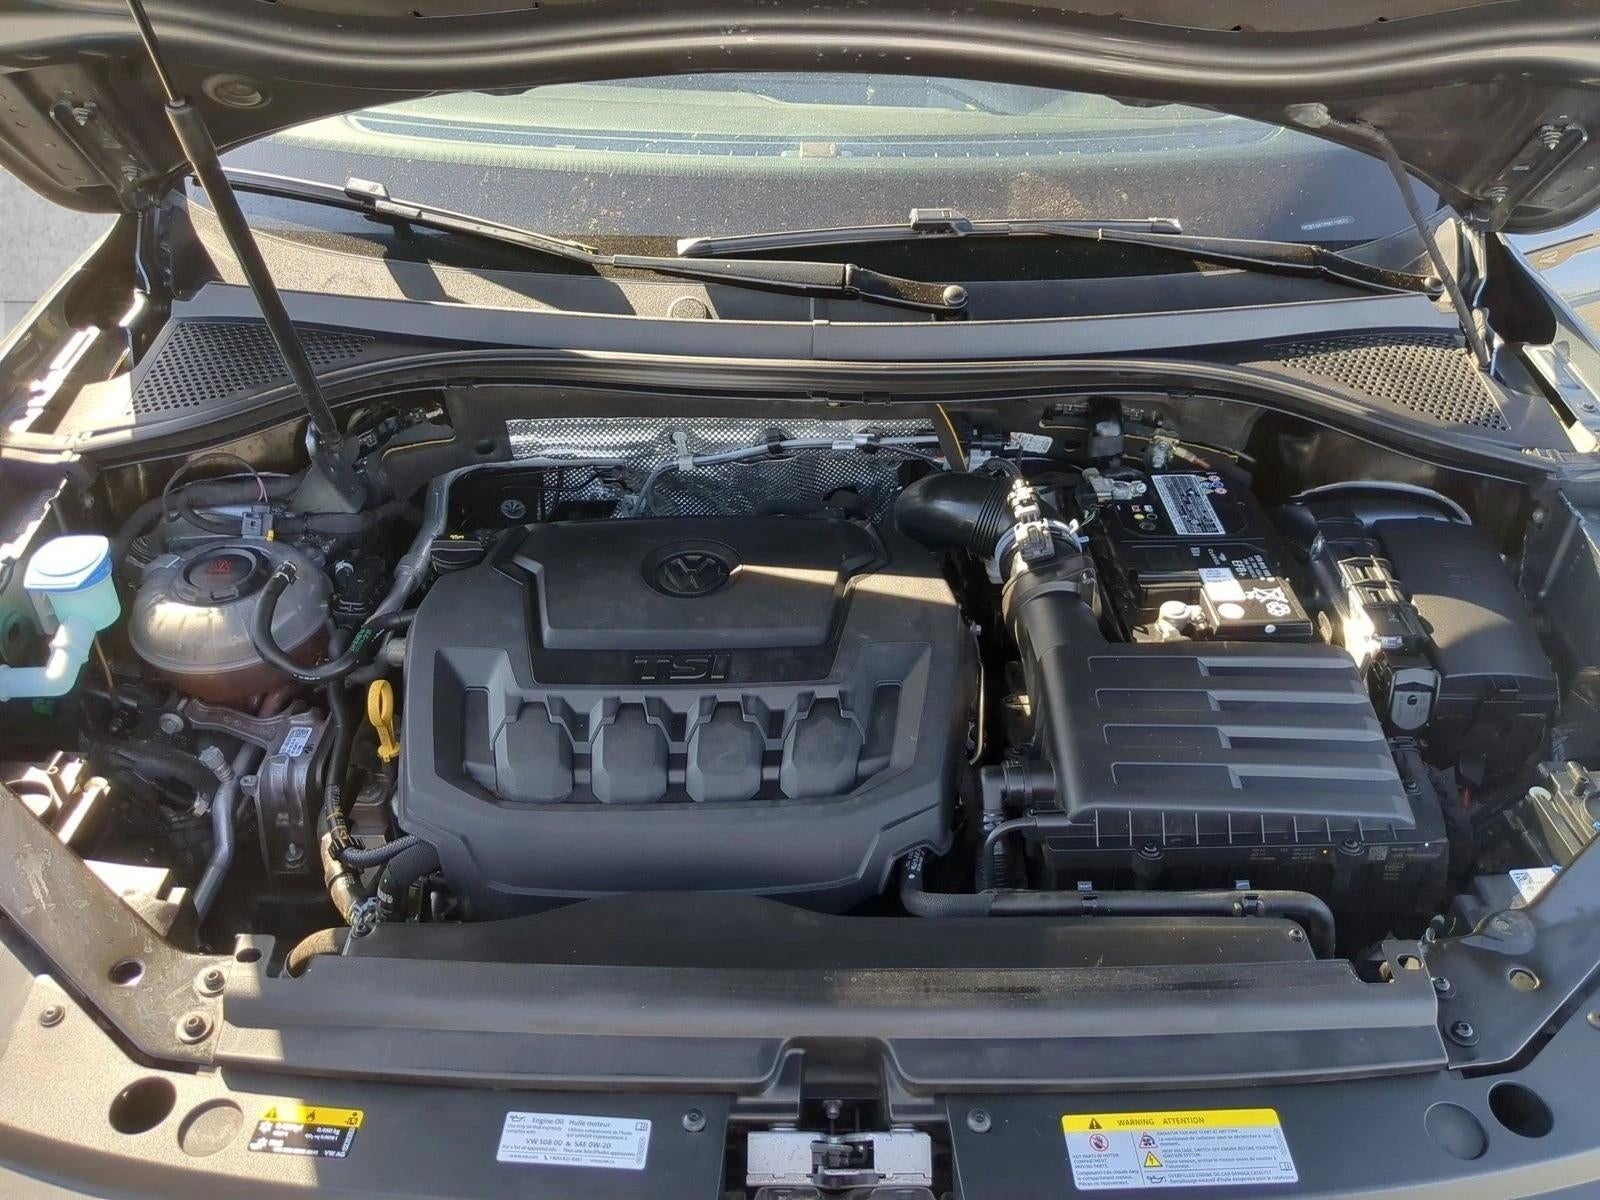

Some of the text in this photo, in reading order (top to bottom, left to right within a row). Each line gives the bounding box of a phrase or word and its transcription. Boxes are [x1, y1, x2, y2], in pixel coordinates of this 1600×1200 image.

[633, 653, 731, 681] TSI
[532, 1117, 564, 1126] Engine Oil
[569, 1119, 585, 1127] Huile
[1116, 1116, 1205, 1126] WARNING ATTENTION
